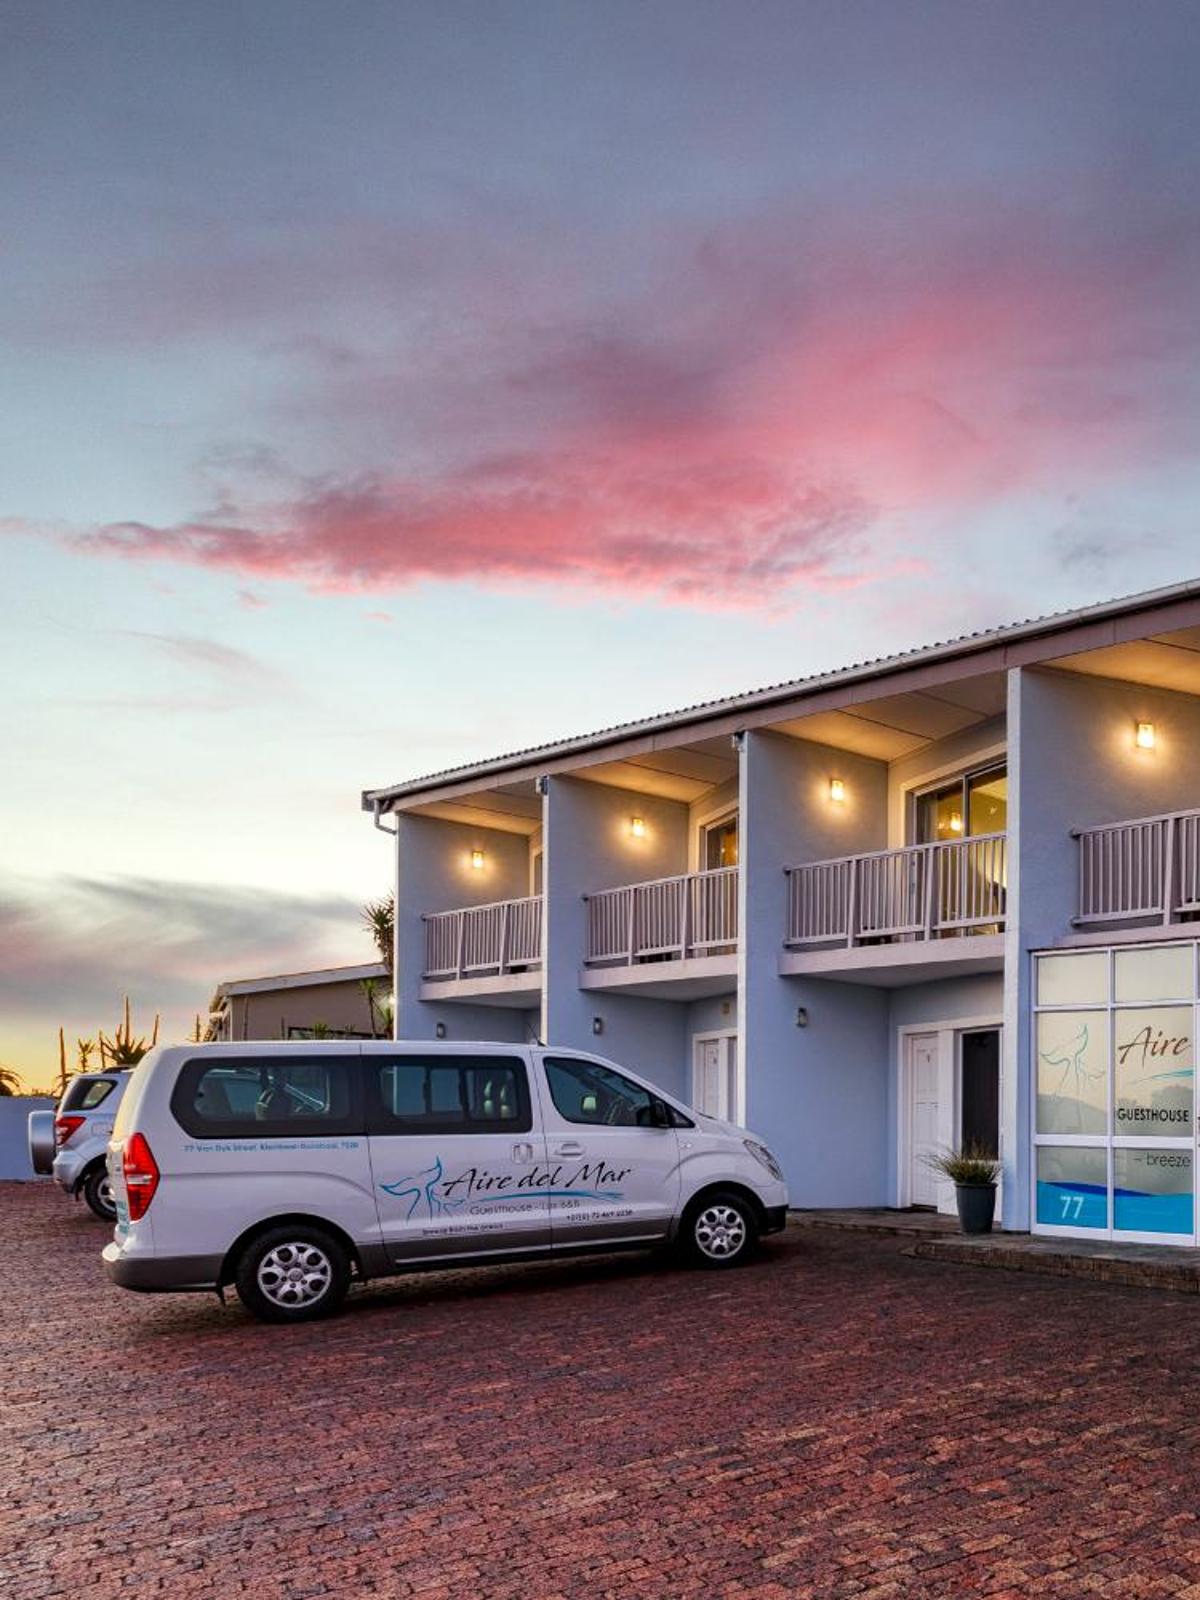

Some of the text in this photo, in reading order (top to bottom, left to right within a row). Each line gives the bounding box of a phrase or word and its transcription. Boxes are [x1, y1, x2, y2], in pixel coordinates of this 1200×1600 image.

[1117, 1025, 1192, 1069] Aire
[1117, 1108, 1190, 1122] GUESTHOUSE
[1146, 1152, 1191, 1167] breeze
[441, 1161, 632, 1198] Aire del Mar
[469, 1203, 533, 1216] Guesthouse
[1060, 1195, 1084, 1219] 77
